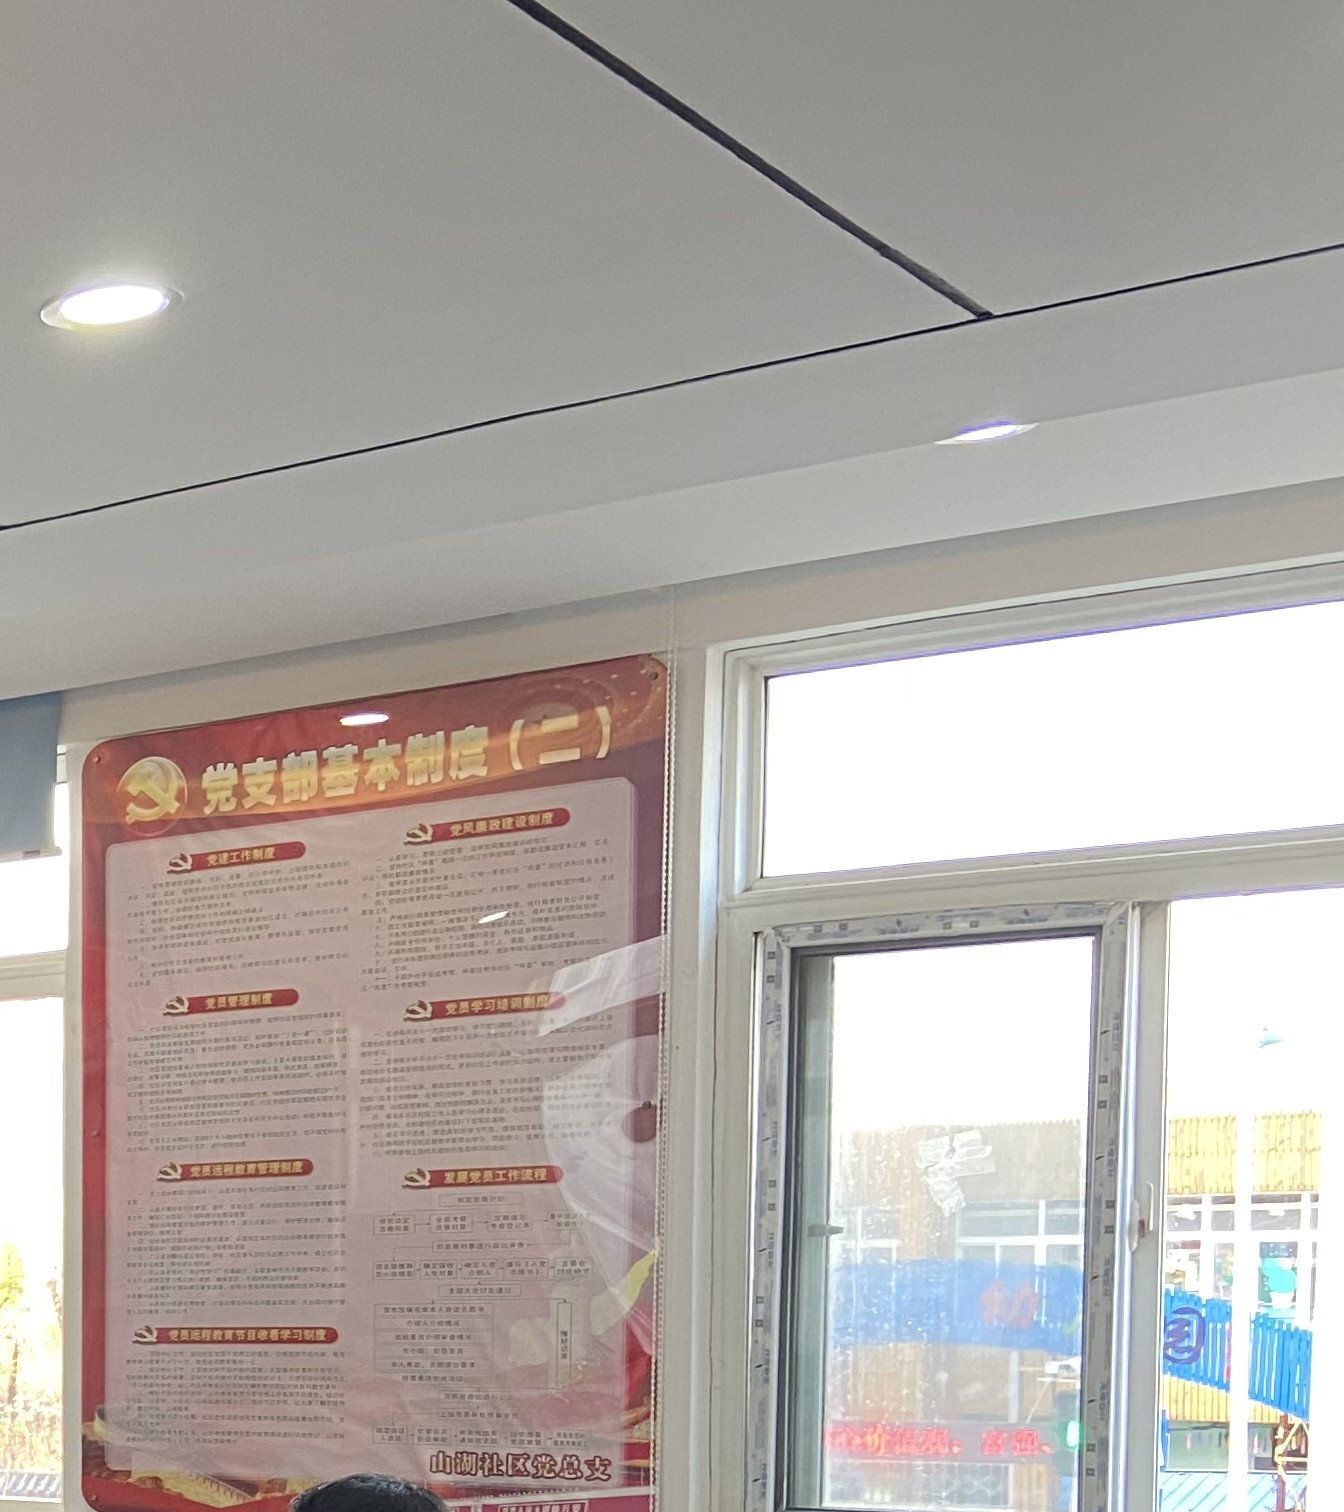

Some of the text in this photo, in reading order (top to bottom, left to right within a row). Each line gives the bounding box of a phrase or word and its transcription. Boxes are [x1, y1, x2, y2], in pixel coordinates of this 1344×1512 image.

[201, 705, 612, 816] 党支部基本制度（二）
[449, 812, 554, 837] 党风廉政建设制度
[207, 847, 276, 867] 党建工作制度
[205, 992, 273, 1010] 党员管理制度
[445, 993, 550, 1016] 党员学习培训制度
[189, 1160, 304, 1177] 党员远程教育管理制度
[444, 1166, 548, 1185] 发展党员工作流程
[168, 1328, 327, 1342] 党员远程教育节目收看学习制度
[429, 1451, 612, 1481] 山湖社区党总支
